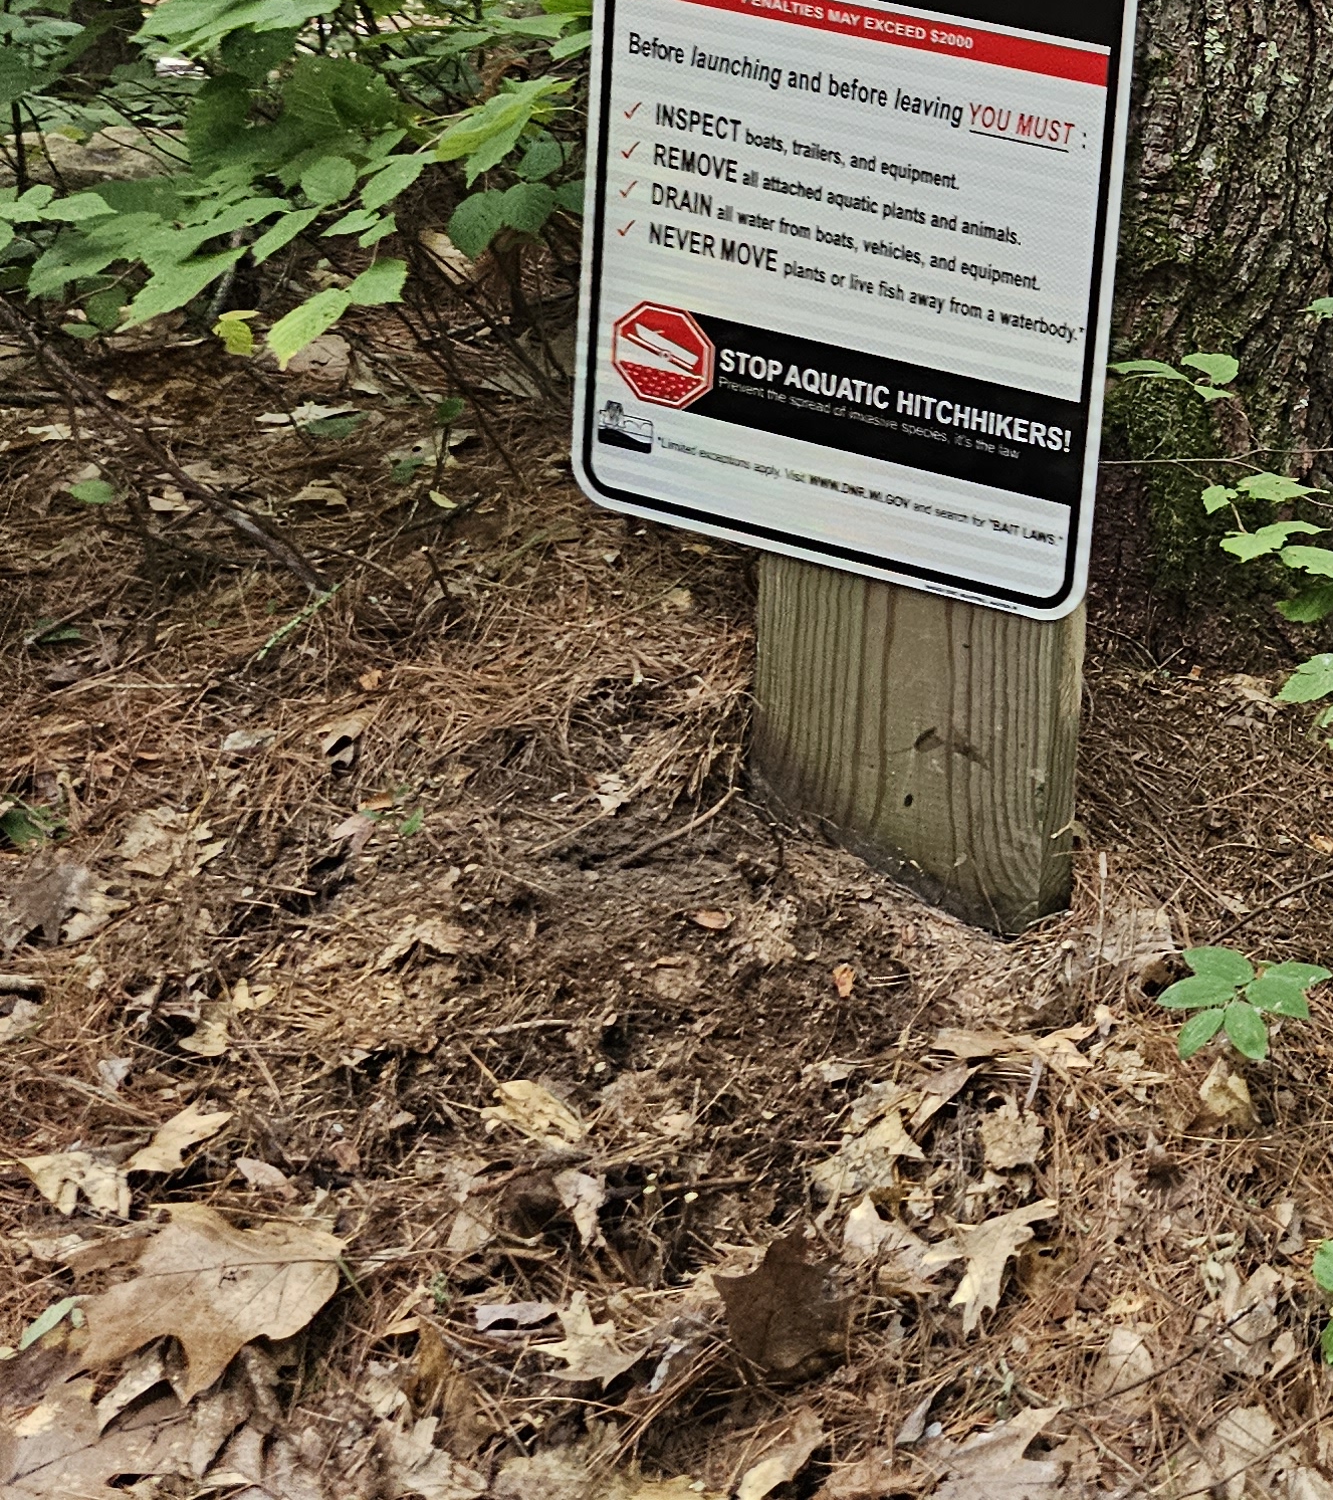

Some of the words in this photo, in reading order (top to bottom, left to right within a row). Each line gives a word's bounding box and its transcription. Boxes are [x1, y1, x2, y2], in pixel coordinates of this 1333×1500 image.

[827, 9, 859, 26] MAY
[863, 15, 926, 41] EXCEED
[930, 28, 973, 49] $2000
[629, 33, 684, 65] Before
[691, 45, 782, 91] launching
[787, 69, 821, 93] and
[828, 74, 887, 108] before
[894, 87, 963, 128] leaving
[969, 103, 1010, 132] YOU
[1016, 114, 1075, 144] MUST
[654, 144, 738, 184] REMOVE
[742, 170, 759, 186] all
[762, 174, 822, 202] attached
[826, 187, 878, 214] aquatic
[882, 199, 926, 226] plants
[931, 213, 957, 231] and
[962, 219, 1022, 245] animals.
[655, 104, 742, 142] INSPECT
[745, 126, 788, 155] boats,
[792, 139, 844, 168] trailers,
[850, 153, 876, 172] and
[881, 160, 960, 190] equipment.
[649, 222, 716, 259] NEVER
[721, 241, 778, 272] MOVE
[783, 259, 826, 285] plants
[830, 274, 844, 287] or
[849, 275, 874, 295] live
[877, 280, 904, 302] fish
[909, 290, 945, 315] away
[949, 297, 982, 320] from
[987, 309, 995, 322] a
[651, 184, 713, 218] DRAIN
[717, 204, 734, 220] all
[738, 210, 775, 234] water
[779, 218, 811, 240] from
[815, 224, 859, 253] boats,
[863, 238, 925, 267] vehicles,
[930, 254, 956, 271] and
[960, 259, 1041, 291] equipment.
[719, 377, 764, 398] Prevent
[767, 389, 787, 402] the
[789, 394, 830, 413] spread
[833, 403, 846, 416] of
[848, 408, 897, 430] invasive
[902, 422, 950, 443] species,
[975, 439, 995, 453] the
[999, 445, 1021, 459] law
[720, 349, 782, 382] STOP
[783, 366, 890, 409] AQUATIC
[897, 391, 1071, 452] HITCHHIKERS!
[914, 503, 931, 515] and
[936, 508, 968, 522] search
[973, 514, 986, 527] for
